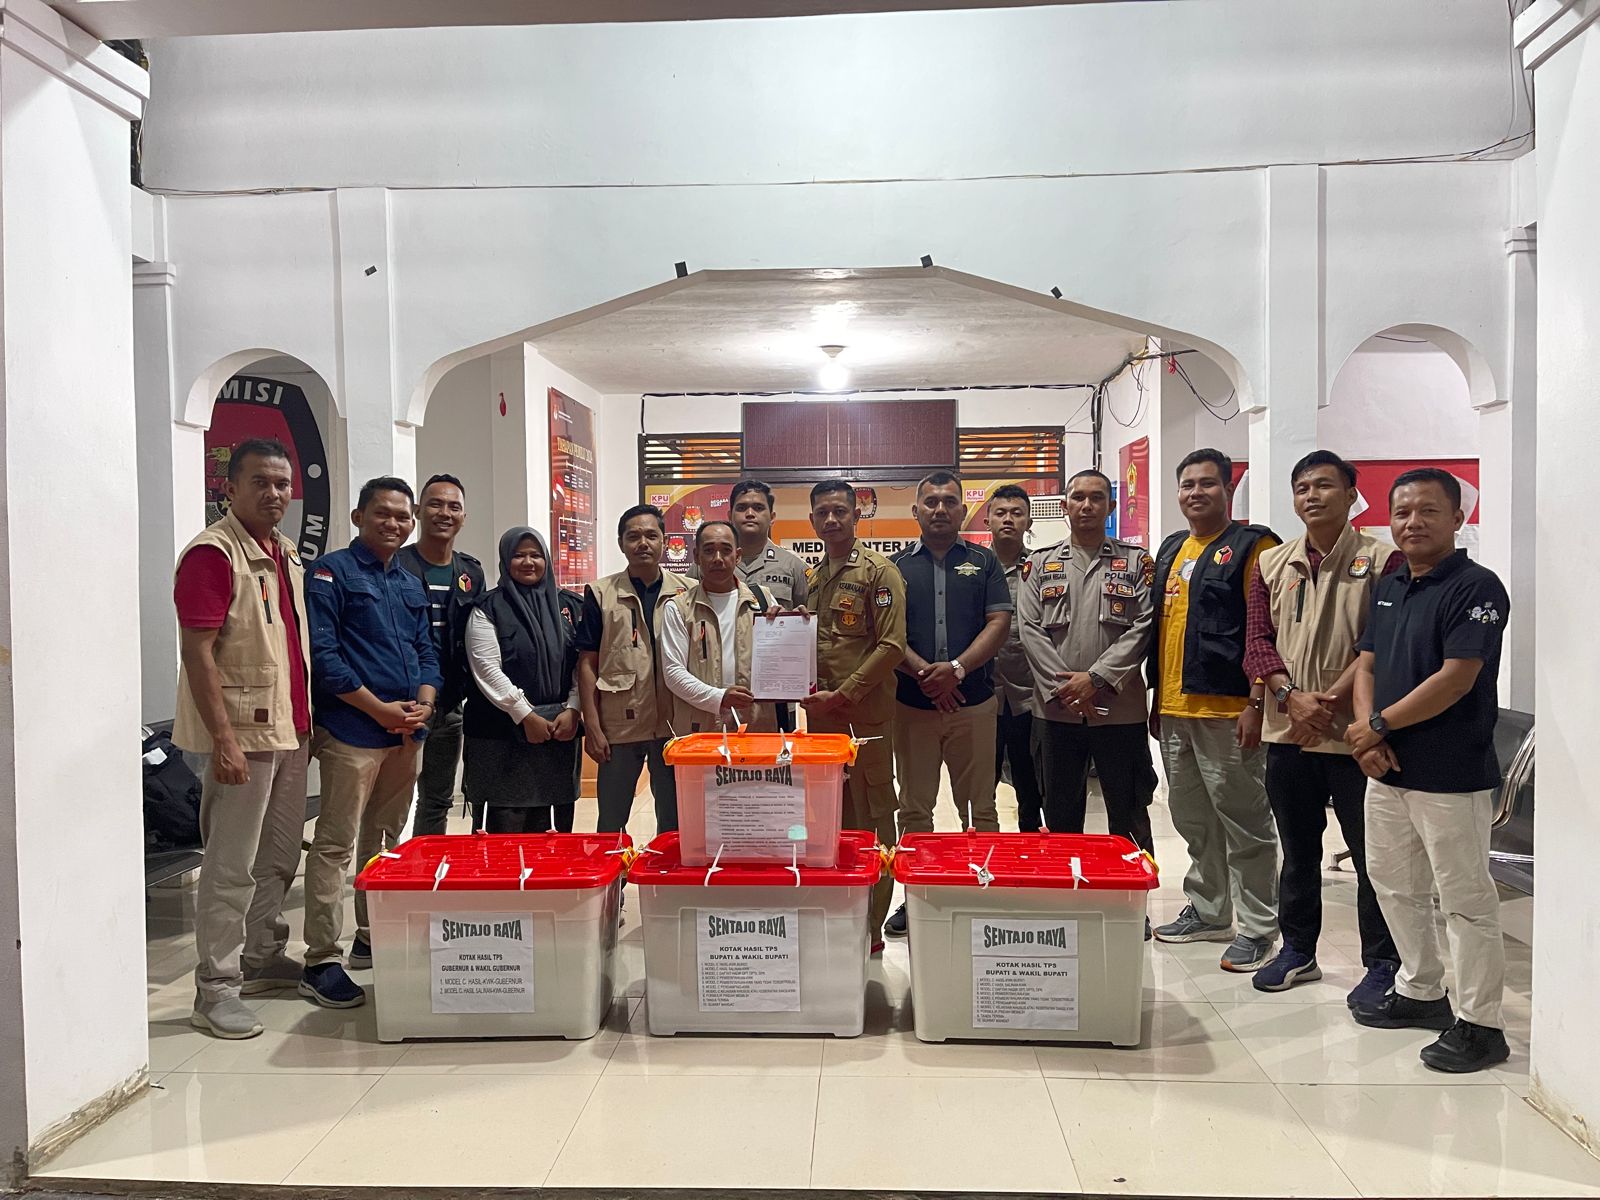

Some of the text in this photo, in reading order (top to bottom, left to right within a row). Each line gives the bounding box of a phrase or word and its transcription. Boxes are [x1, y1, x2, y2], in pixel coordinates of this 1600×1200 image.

[765, 575, 791, 585] POLRI
[715, 764, 793, 787] SENTAJO RAYA
[442, 918, 522, 942] SENTAJO RAYA
[708, 915, 786, 939] SENTAJO RAYA
[983, 924, 1067, 949] SENTAJO RAYA
[444, 978, 461, 986] MODEL
